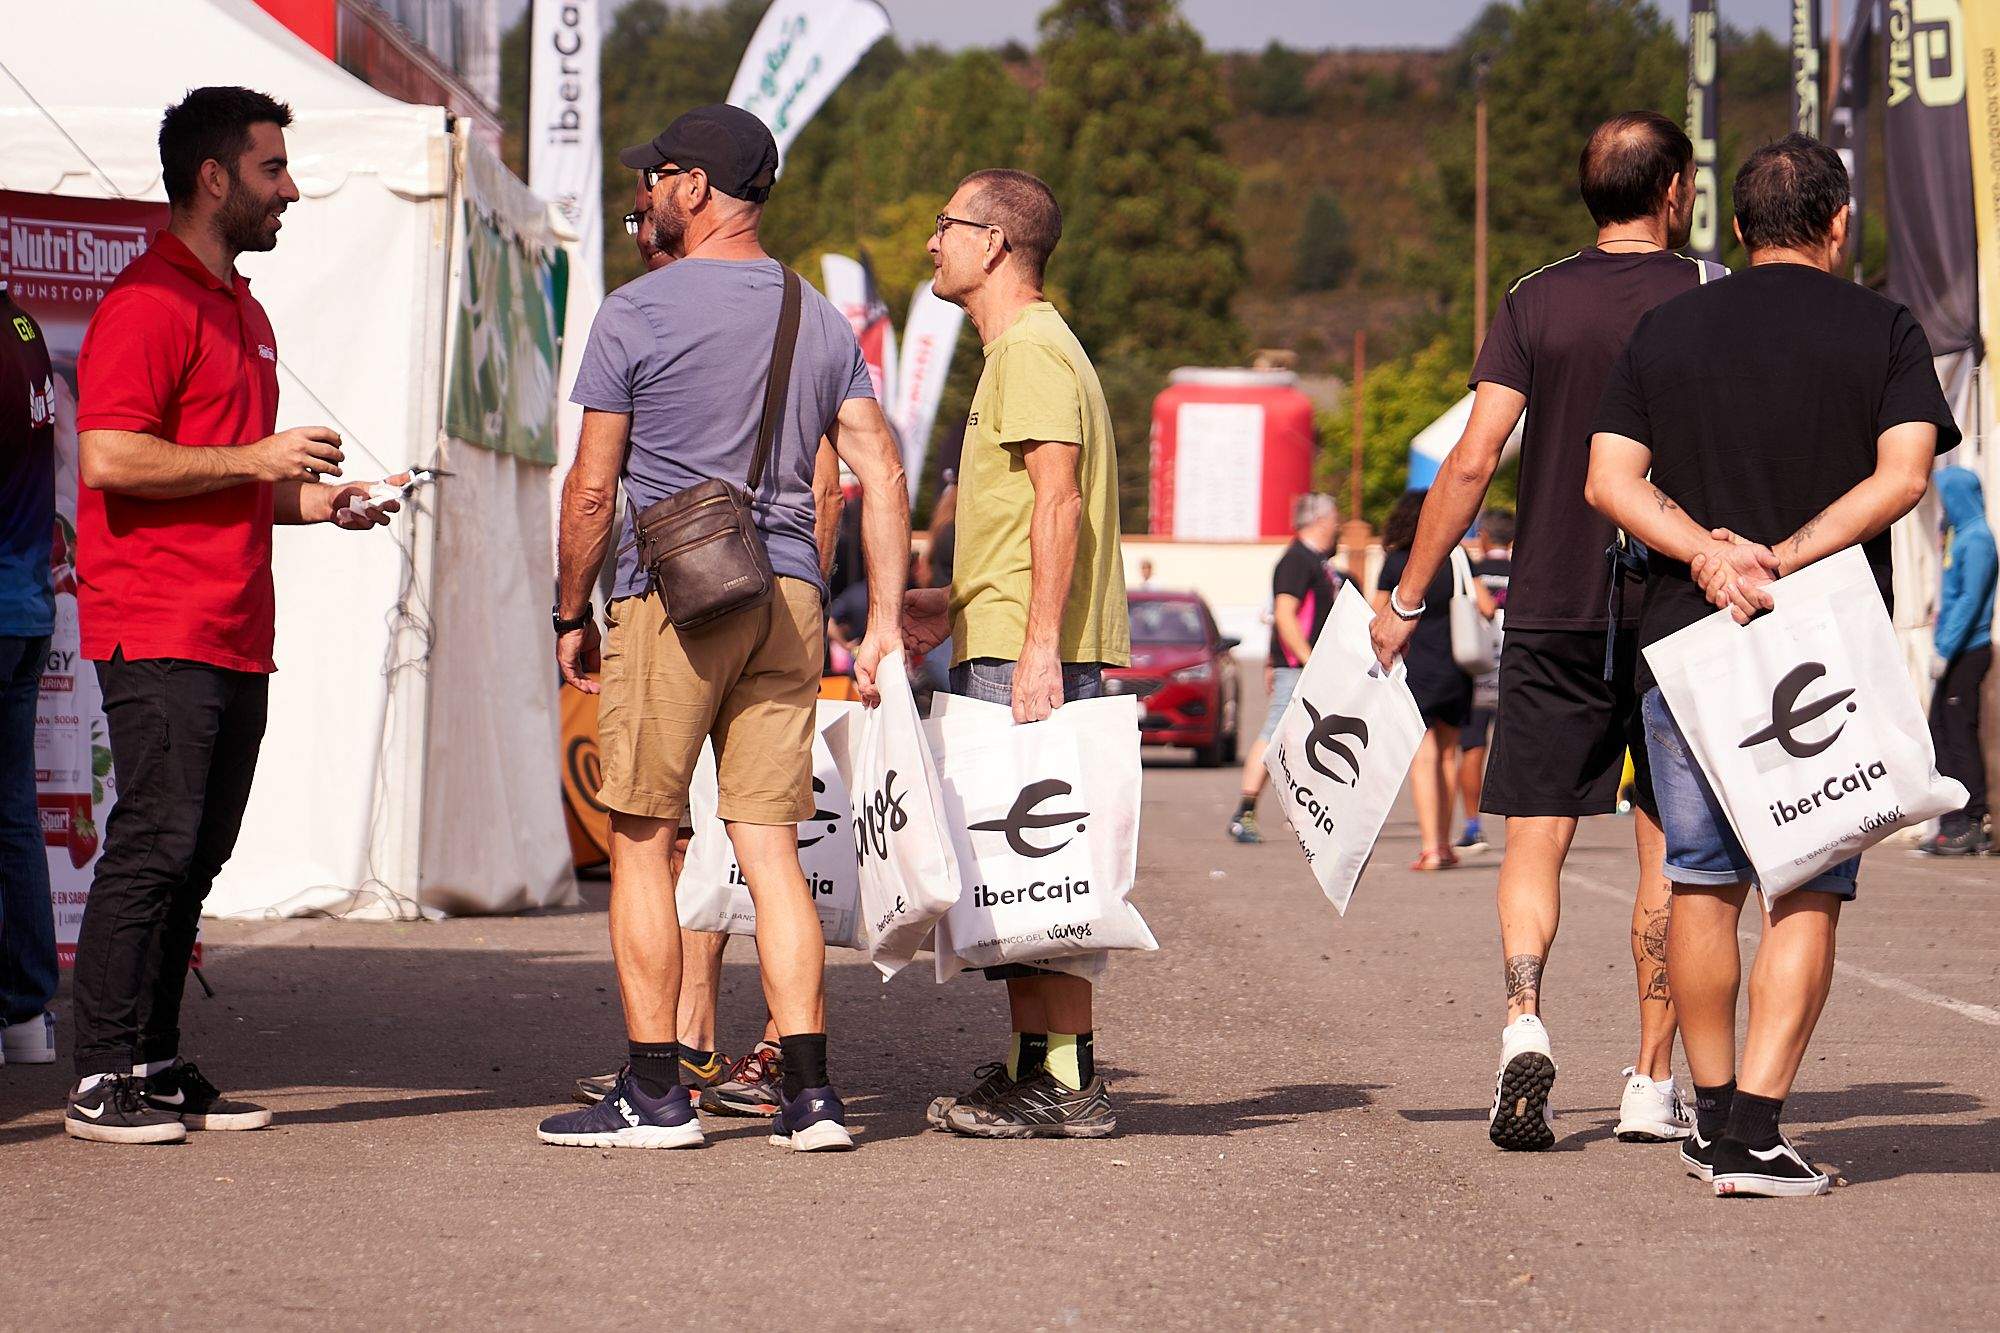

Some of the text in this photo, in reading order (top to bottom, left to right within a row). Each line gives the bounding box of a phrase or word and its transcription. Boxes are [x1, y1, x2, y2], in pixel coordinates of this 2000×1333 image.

[1278, 743, 1335, 836] iberCaja
[1769, 759, 1888, 827] iberCaja
[1793, 857, 1807, 867] EL
[1807, 840, 1839, 861] BANCO
[973, 876, 1090, 908] iberCaja
[718, 911, 729, 920] EL
[977, 940, 990, 948] EL
[991, 935, 1025, 947] BANCO
[1026, 933, 1045, 943] DEL
